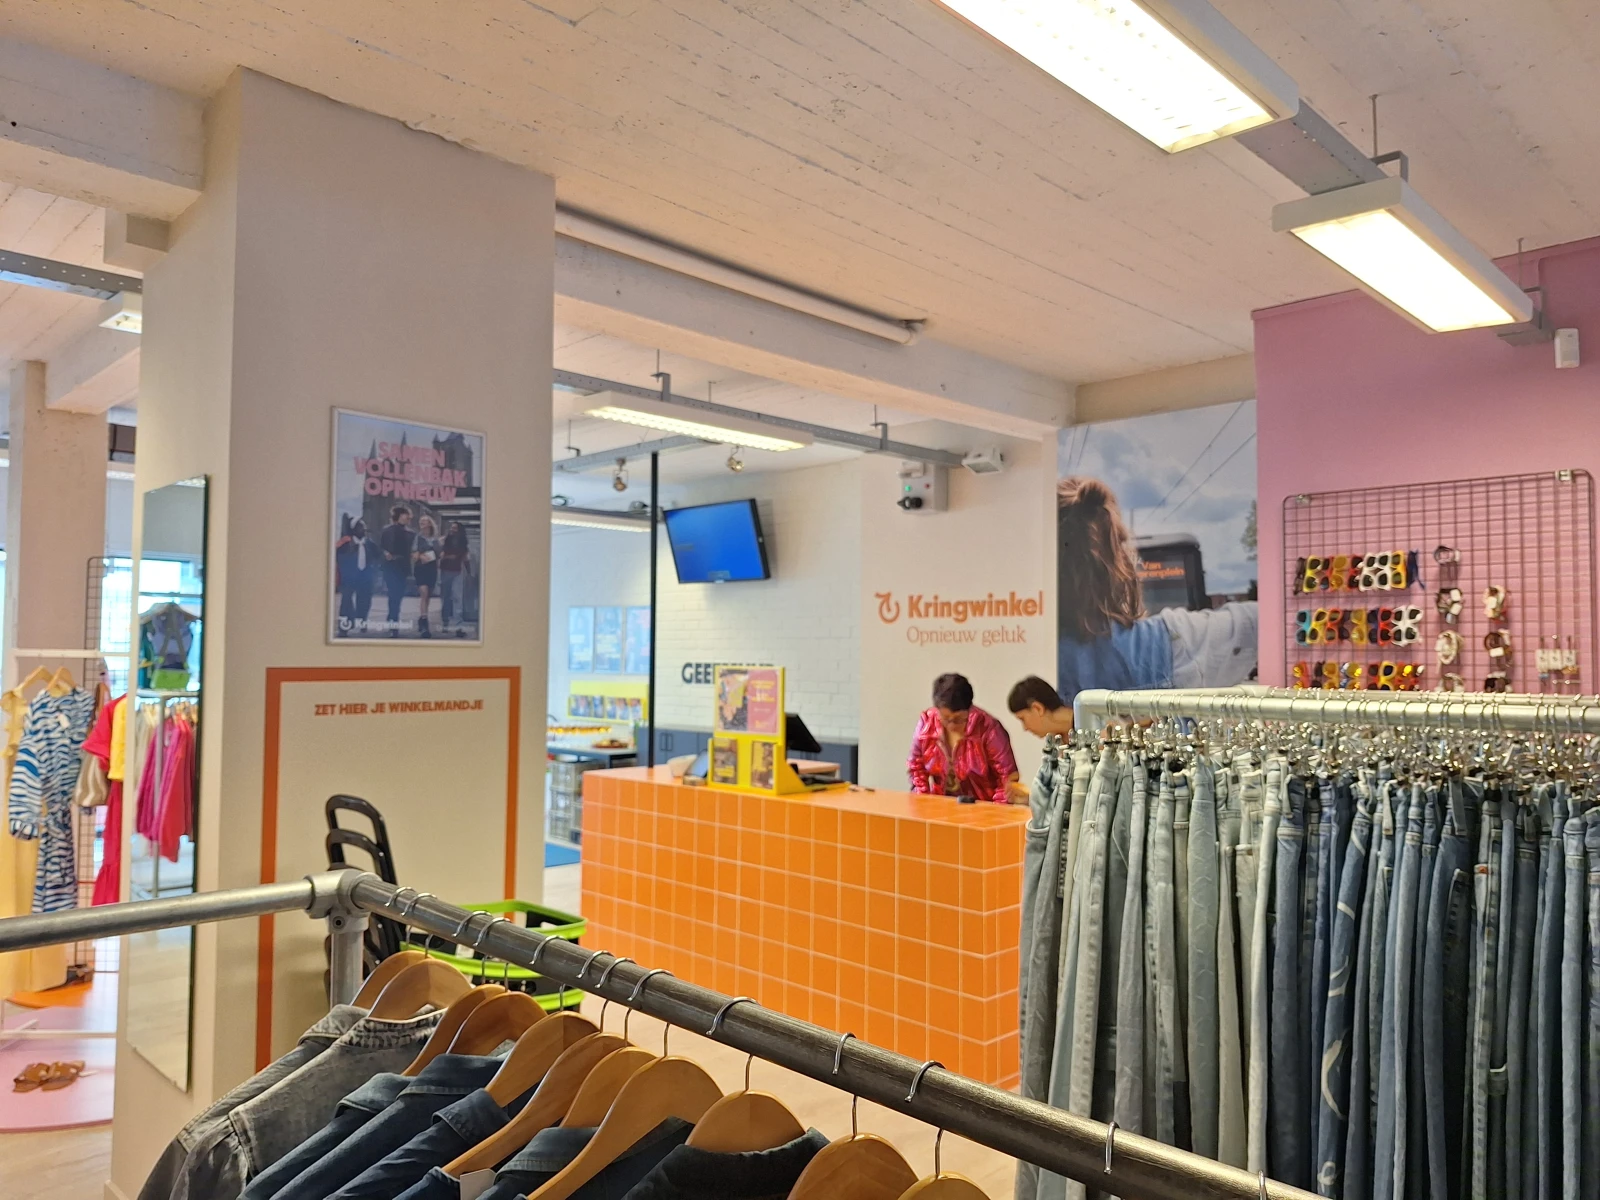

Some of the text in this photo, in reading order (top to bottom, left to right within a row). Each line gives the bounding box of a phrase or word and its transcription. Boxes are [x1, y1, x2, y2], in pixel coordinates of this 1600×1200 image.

[378, 441, 446, 468] SAMEN
[353, 456, 467, 488] VOLLENBAK
[364, 477, 456, 503] OPNIEUW
[907, 590, 1043, 623] Kringwinkel
[906, 624, 1026, 647] Opnieuw geluk
[314, 699, 485, 716] ZET HIER JE WINKELMANDJE
